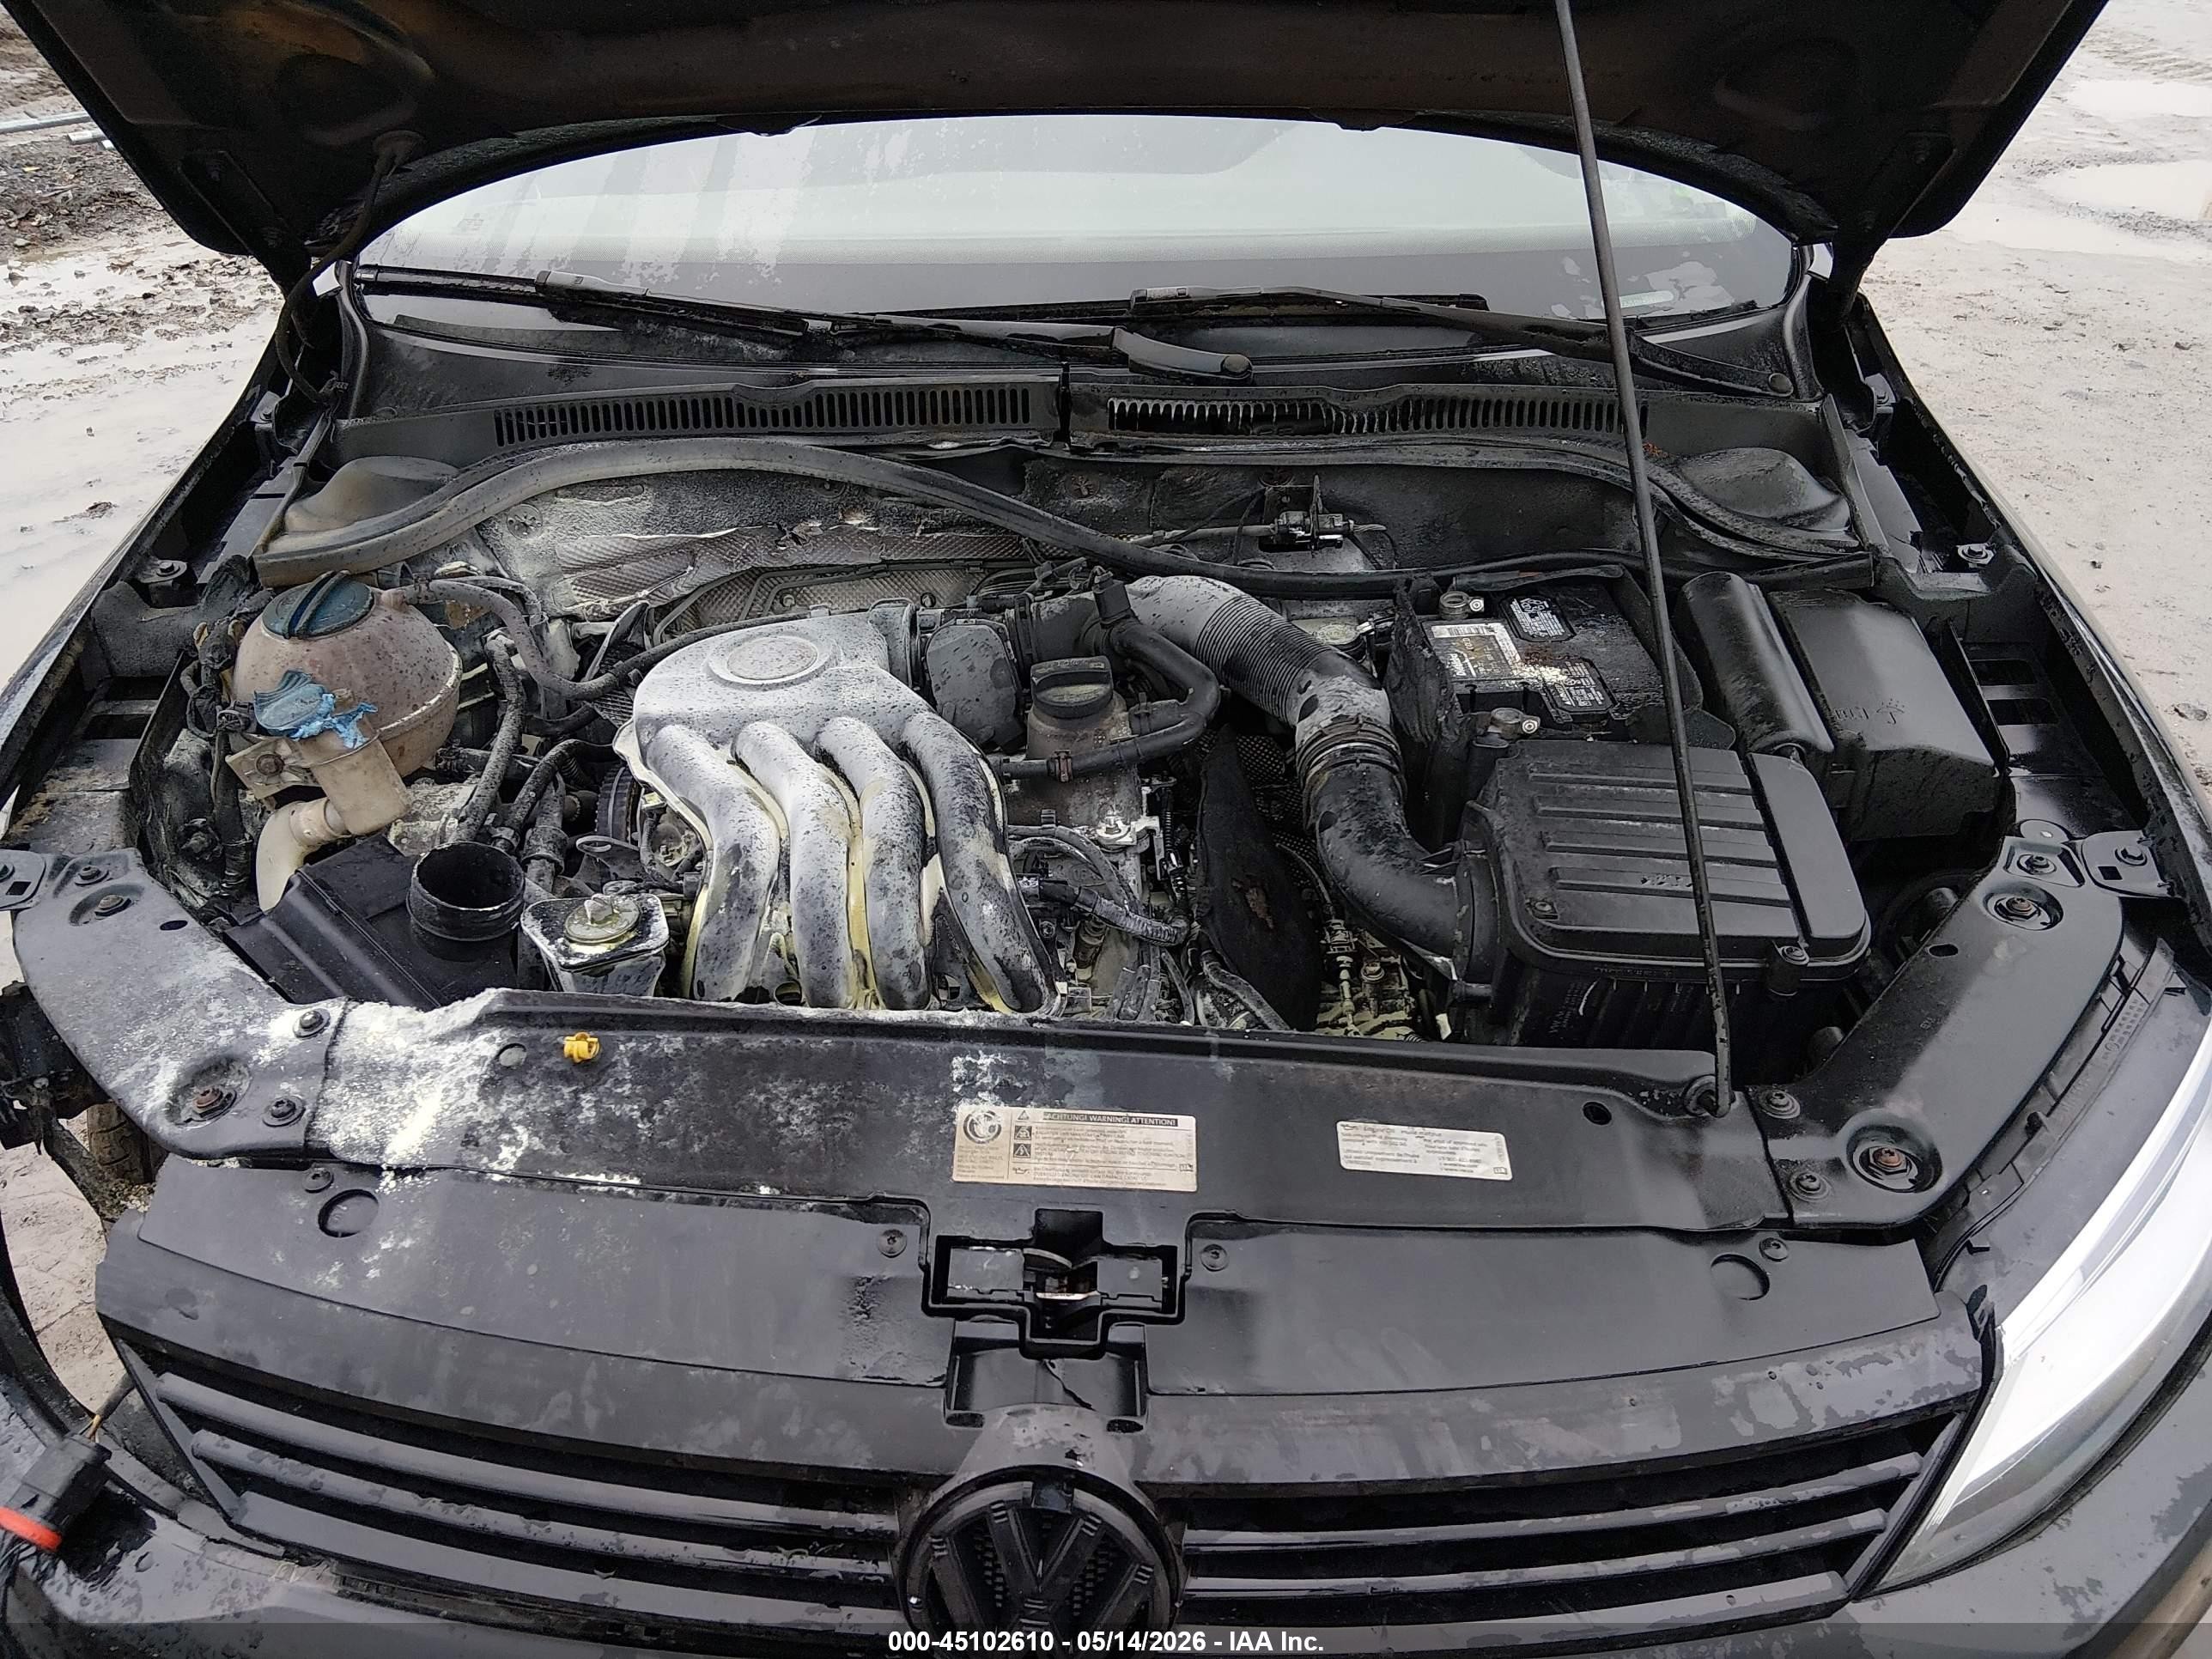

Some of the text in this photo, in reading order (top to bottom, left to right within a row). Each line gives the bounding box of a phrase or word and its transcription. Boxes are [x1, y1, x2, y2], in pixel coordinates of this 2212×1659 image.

[1047, 1112, 1176, 1127] ACHTUNG! WARNING! ATTENTION!
